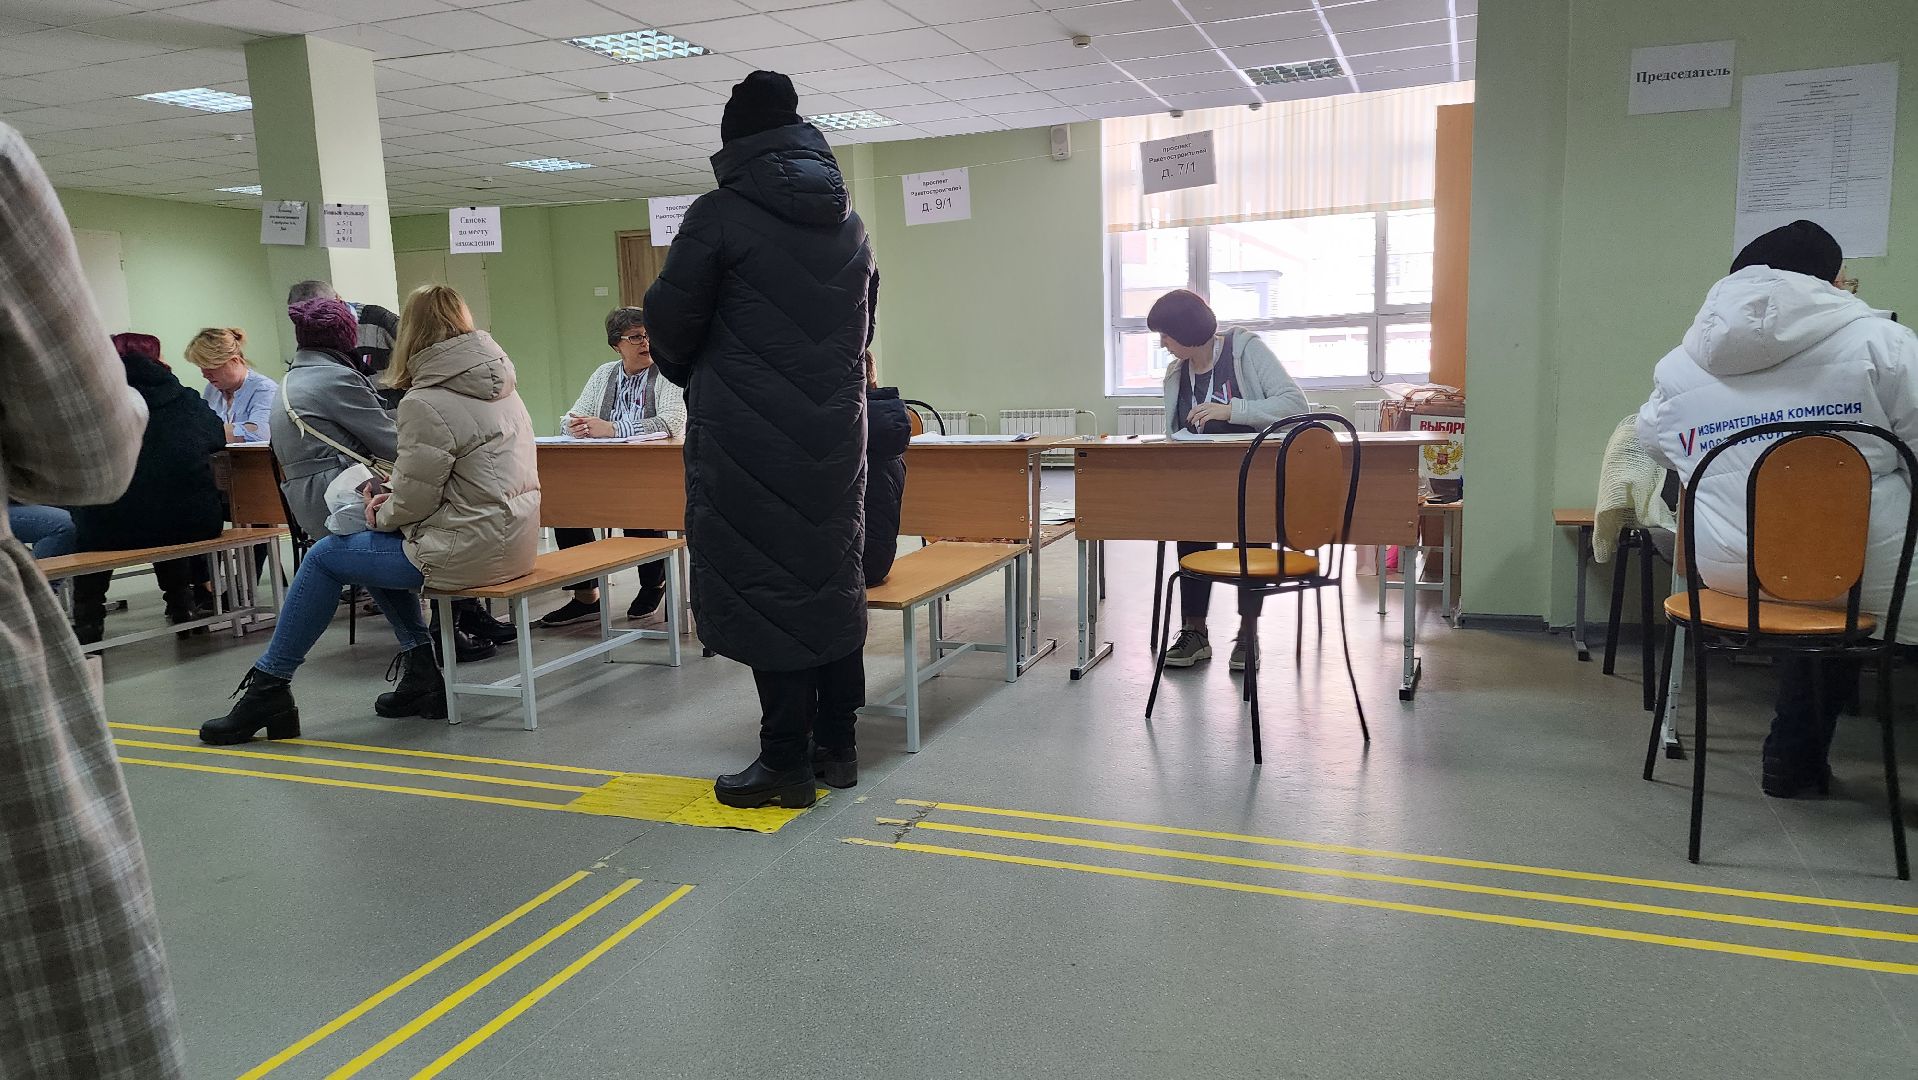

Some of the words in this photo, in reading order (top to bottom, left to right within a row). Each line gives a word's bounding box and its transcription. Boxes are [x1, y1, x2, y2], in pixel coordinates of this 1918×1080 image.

[1636, 67, 1731, 84] Председатель
[1162, 142, 1192, 153] проспект
[1148, 148, 1207, 163] Ракетостроителей
[1177, 161, 1196, 175] 7/1
[922, 179, 949, 187] проспект
[935, 197, 952, 210] 9/1
[460, 216, 487, 224] Список
[1698, 410, 1783, 436] ИЗБИРАТЕЛЬНАЯ
[1787, 402, 1862, 419] КОМИССИЯ
